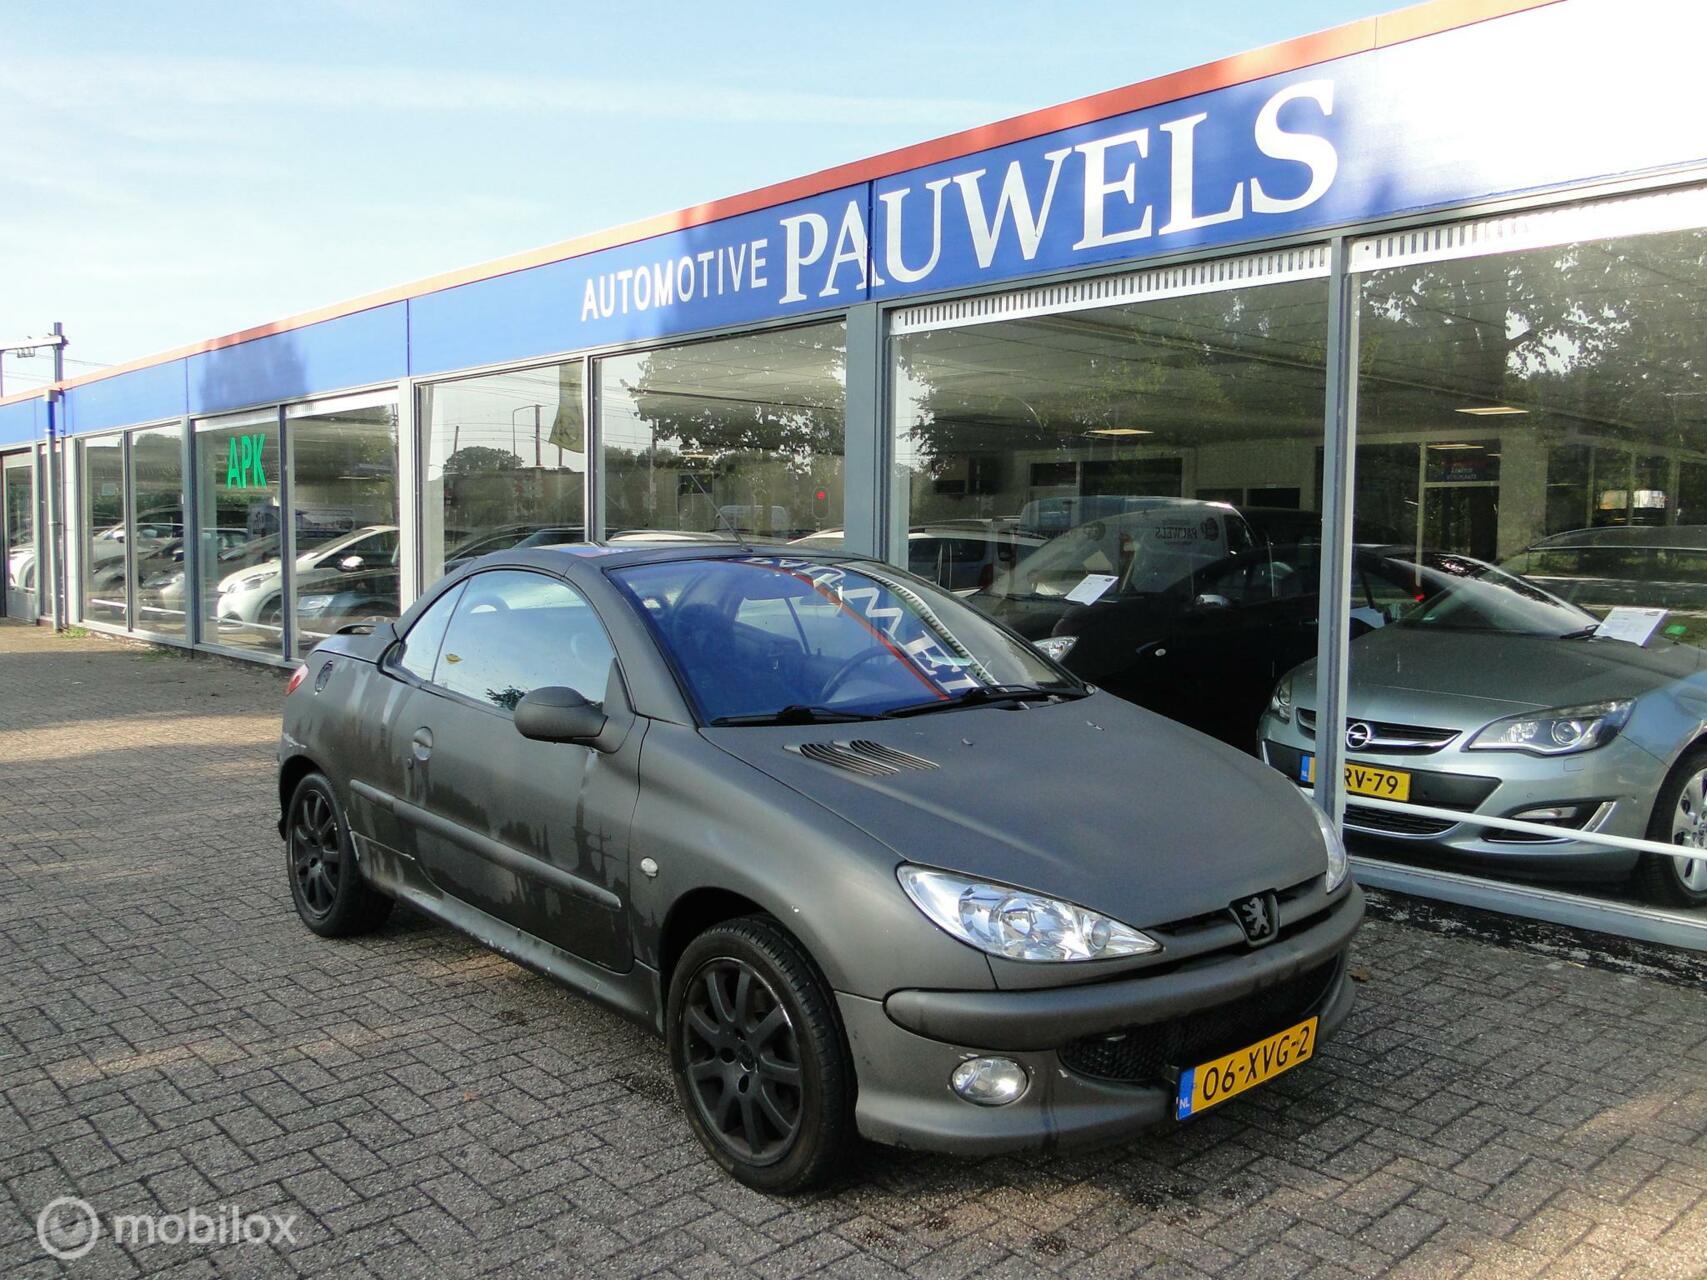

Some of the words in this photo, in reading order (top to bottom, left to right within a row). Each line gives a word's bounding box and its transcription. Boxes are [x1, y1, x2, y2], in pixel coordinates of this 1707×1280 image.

[581, 238, 768, 322] AUTOMOTIVE
[779, 79, 1338, 304] PAUWELS
[227, 433, 267, 489] APK
[1202, 1026, 1310, 1101] 06-XVG-2
[1179, 1097, 1190, 1109] NL
